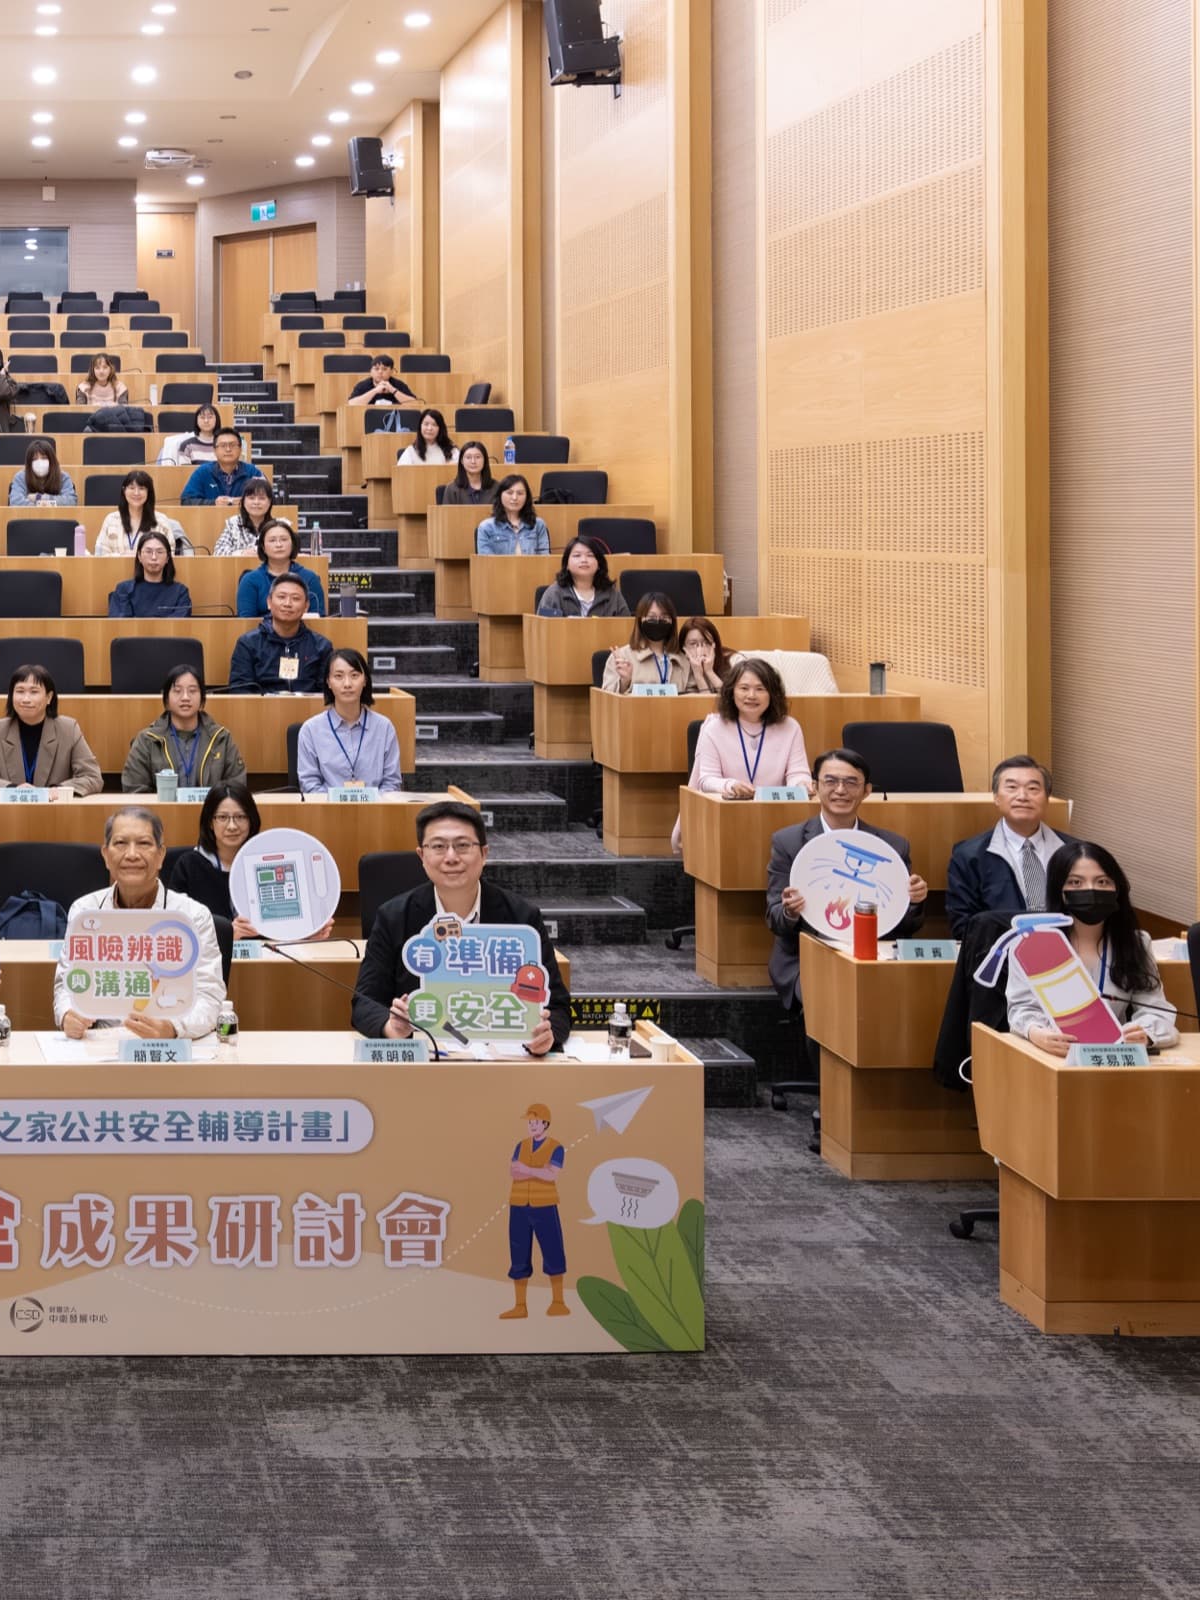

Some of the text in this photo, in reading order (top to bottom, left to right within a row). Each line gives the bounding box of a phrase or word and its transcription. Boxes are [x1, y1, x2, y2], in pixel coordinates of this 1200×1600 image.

[68, 935, 184, 962] 風險辨識
[411, 939, 523, 975] 有準備
[71, 970, 151, 997] 與溝通
[412, 992, 526, 1029] 更安全
[44, 1194, 449, 1263] 成果研討會
[15, 1309, 40, 1321] CSD
